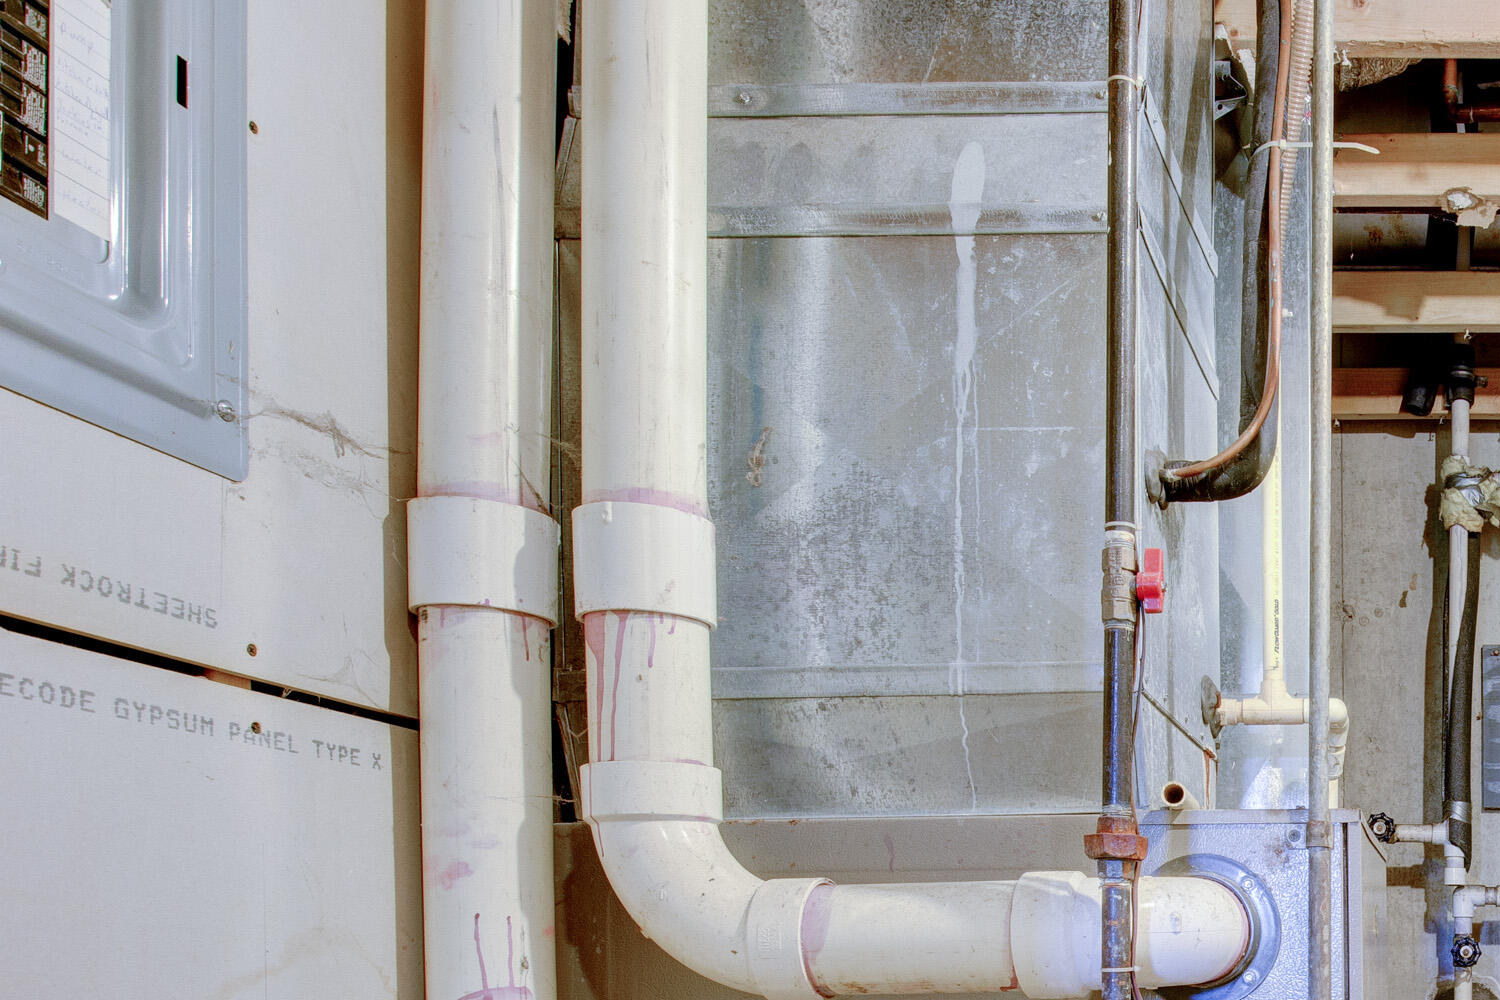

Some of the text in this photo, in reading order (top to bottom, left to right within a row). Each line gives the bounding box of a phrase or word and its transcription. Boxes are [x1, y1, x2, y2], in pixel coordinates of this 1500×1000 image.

[61, 564, 218, 629] SHEETROCK
[114, 697, 215, 737] GYPSUM
[313, 739, 361, 767] TYPE
[372, 752, 383, 771] X
